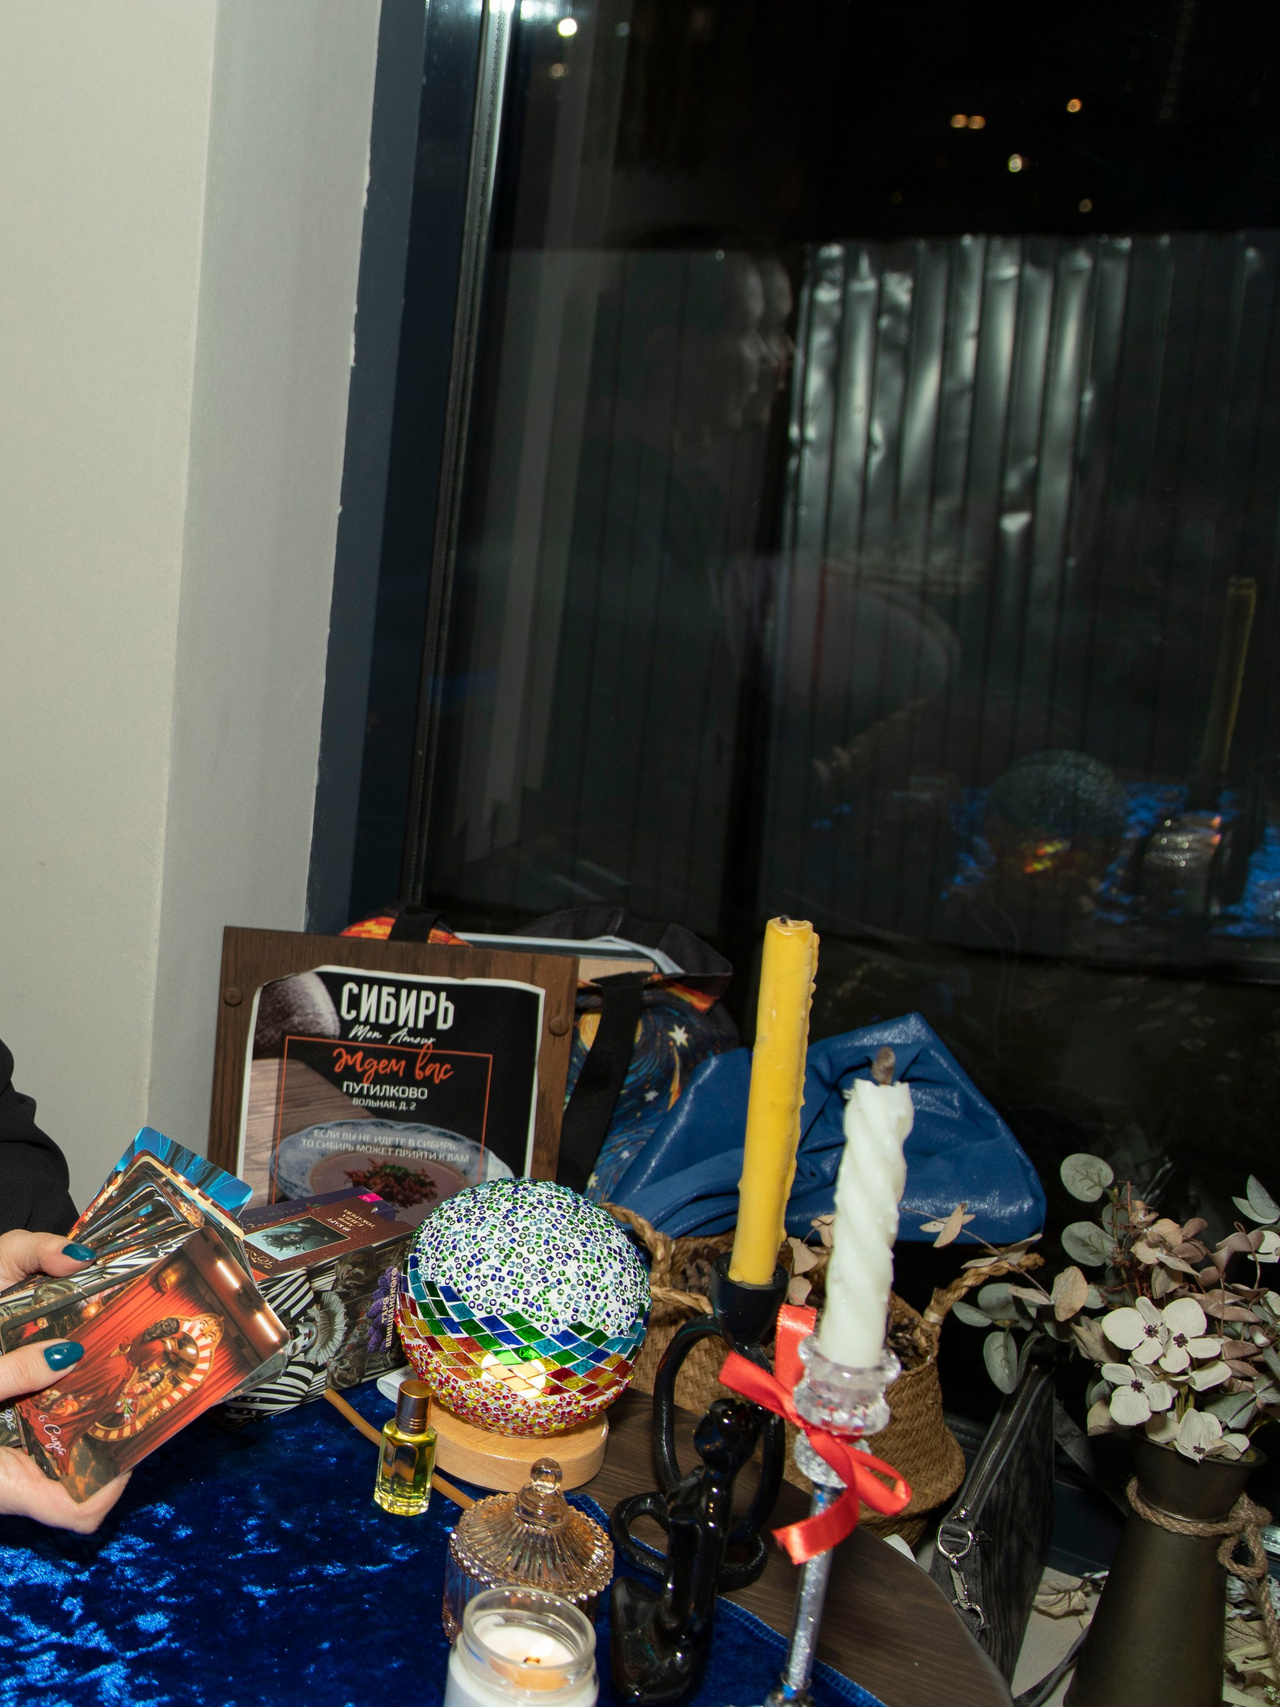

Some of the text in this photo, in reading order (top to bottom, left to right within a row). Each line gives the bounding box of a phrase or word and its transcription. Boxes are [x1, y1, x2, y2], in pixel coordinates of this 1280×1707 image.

[340, 981, 455, 1031] СИБИРЬ
[348, 1024, 437, 1045] Mon Amour
[341, 1080, 429, 1100] ПУТИЛКОВО
[352, 1096, 398, 1110] ВОЛЬНАЯ,
[409, 1101, 417, 1111] 2
[301, 1138, 470, 1163] ТО СИБИРЬ МОЖЕТ ПРИЙТИ К ВАМ
[313, 1128, 458, 1152] ЕСЛИ ВЫ НЕ ИДЕТЕ В СИБИРЬ,
[381, 1295, 390, 1324] ТАРО
[38, 1413, 67, 1456] 6 Cups
